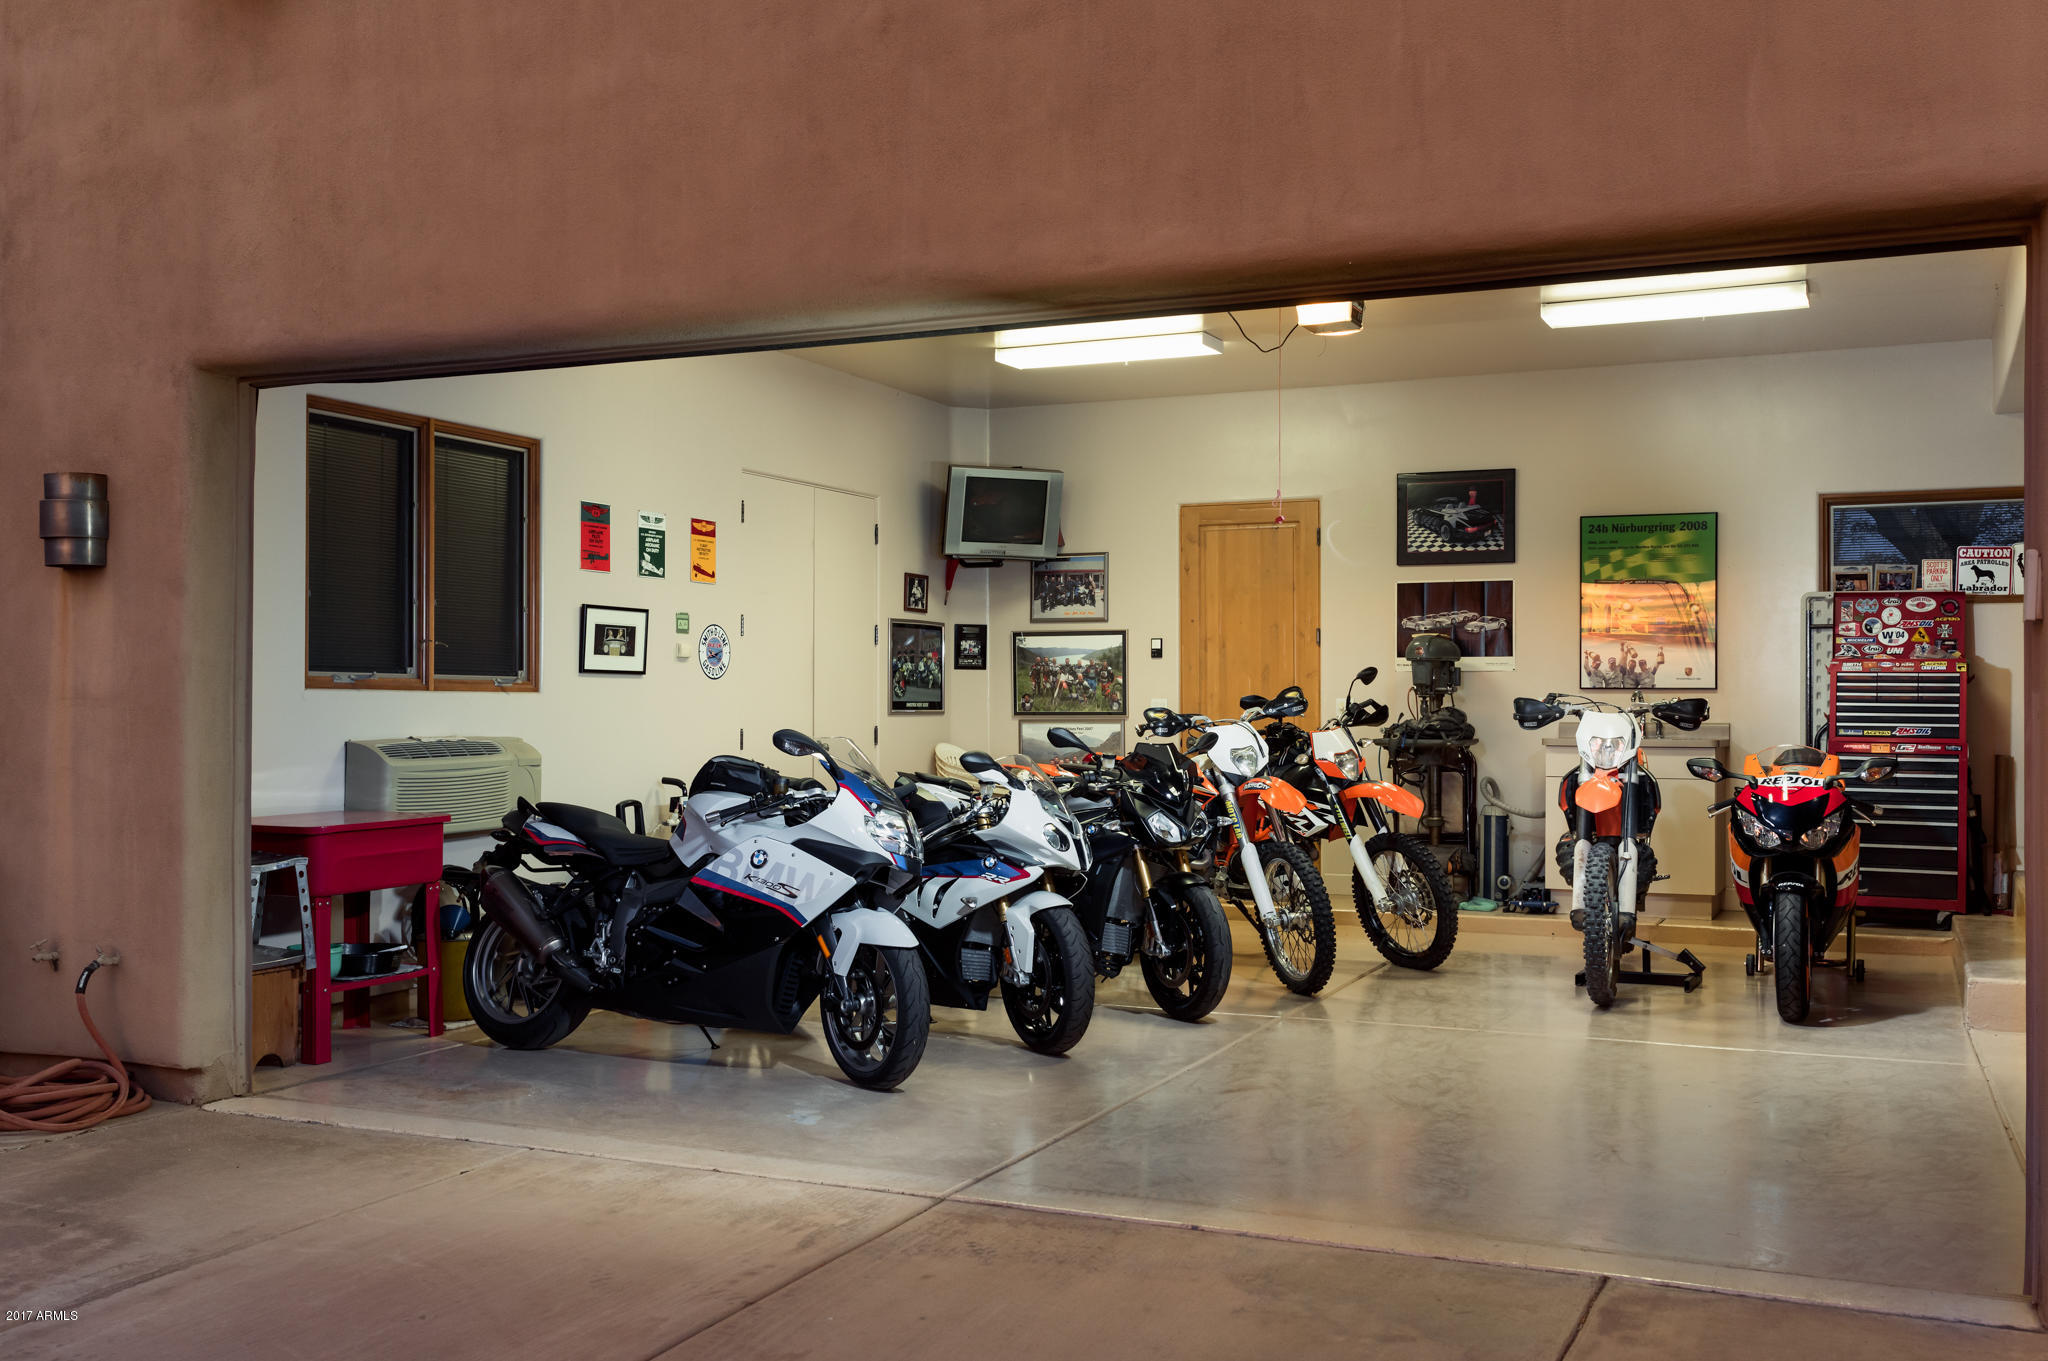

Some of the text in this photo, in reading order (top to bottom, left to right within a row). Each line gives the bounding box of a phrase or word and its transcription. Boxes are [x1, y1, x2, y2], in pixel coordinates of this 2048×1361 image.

[1588, 521, 1708, 534] 24h Nürburgring 2008
[1960, 549, 2011, 558] CAUTION
[1959, 584, 2008, 592] Labrador
[1882, 631, 1894, 639] W
[702, 659, 726, 676] GASOLINE
[1895, 727, 1931, 735] AMSOIL
